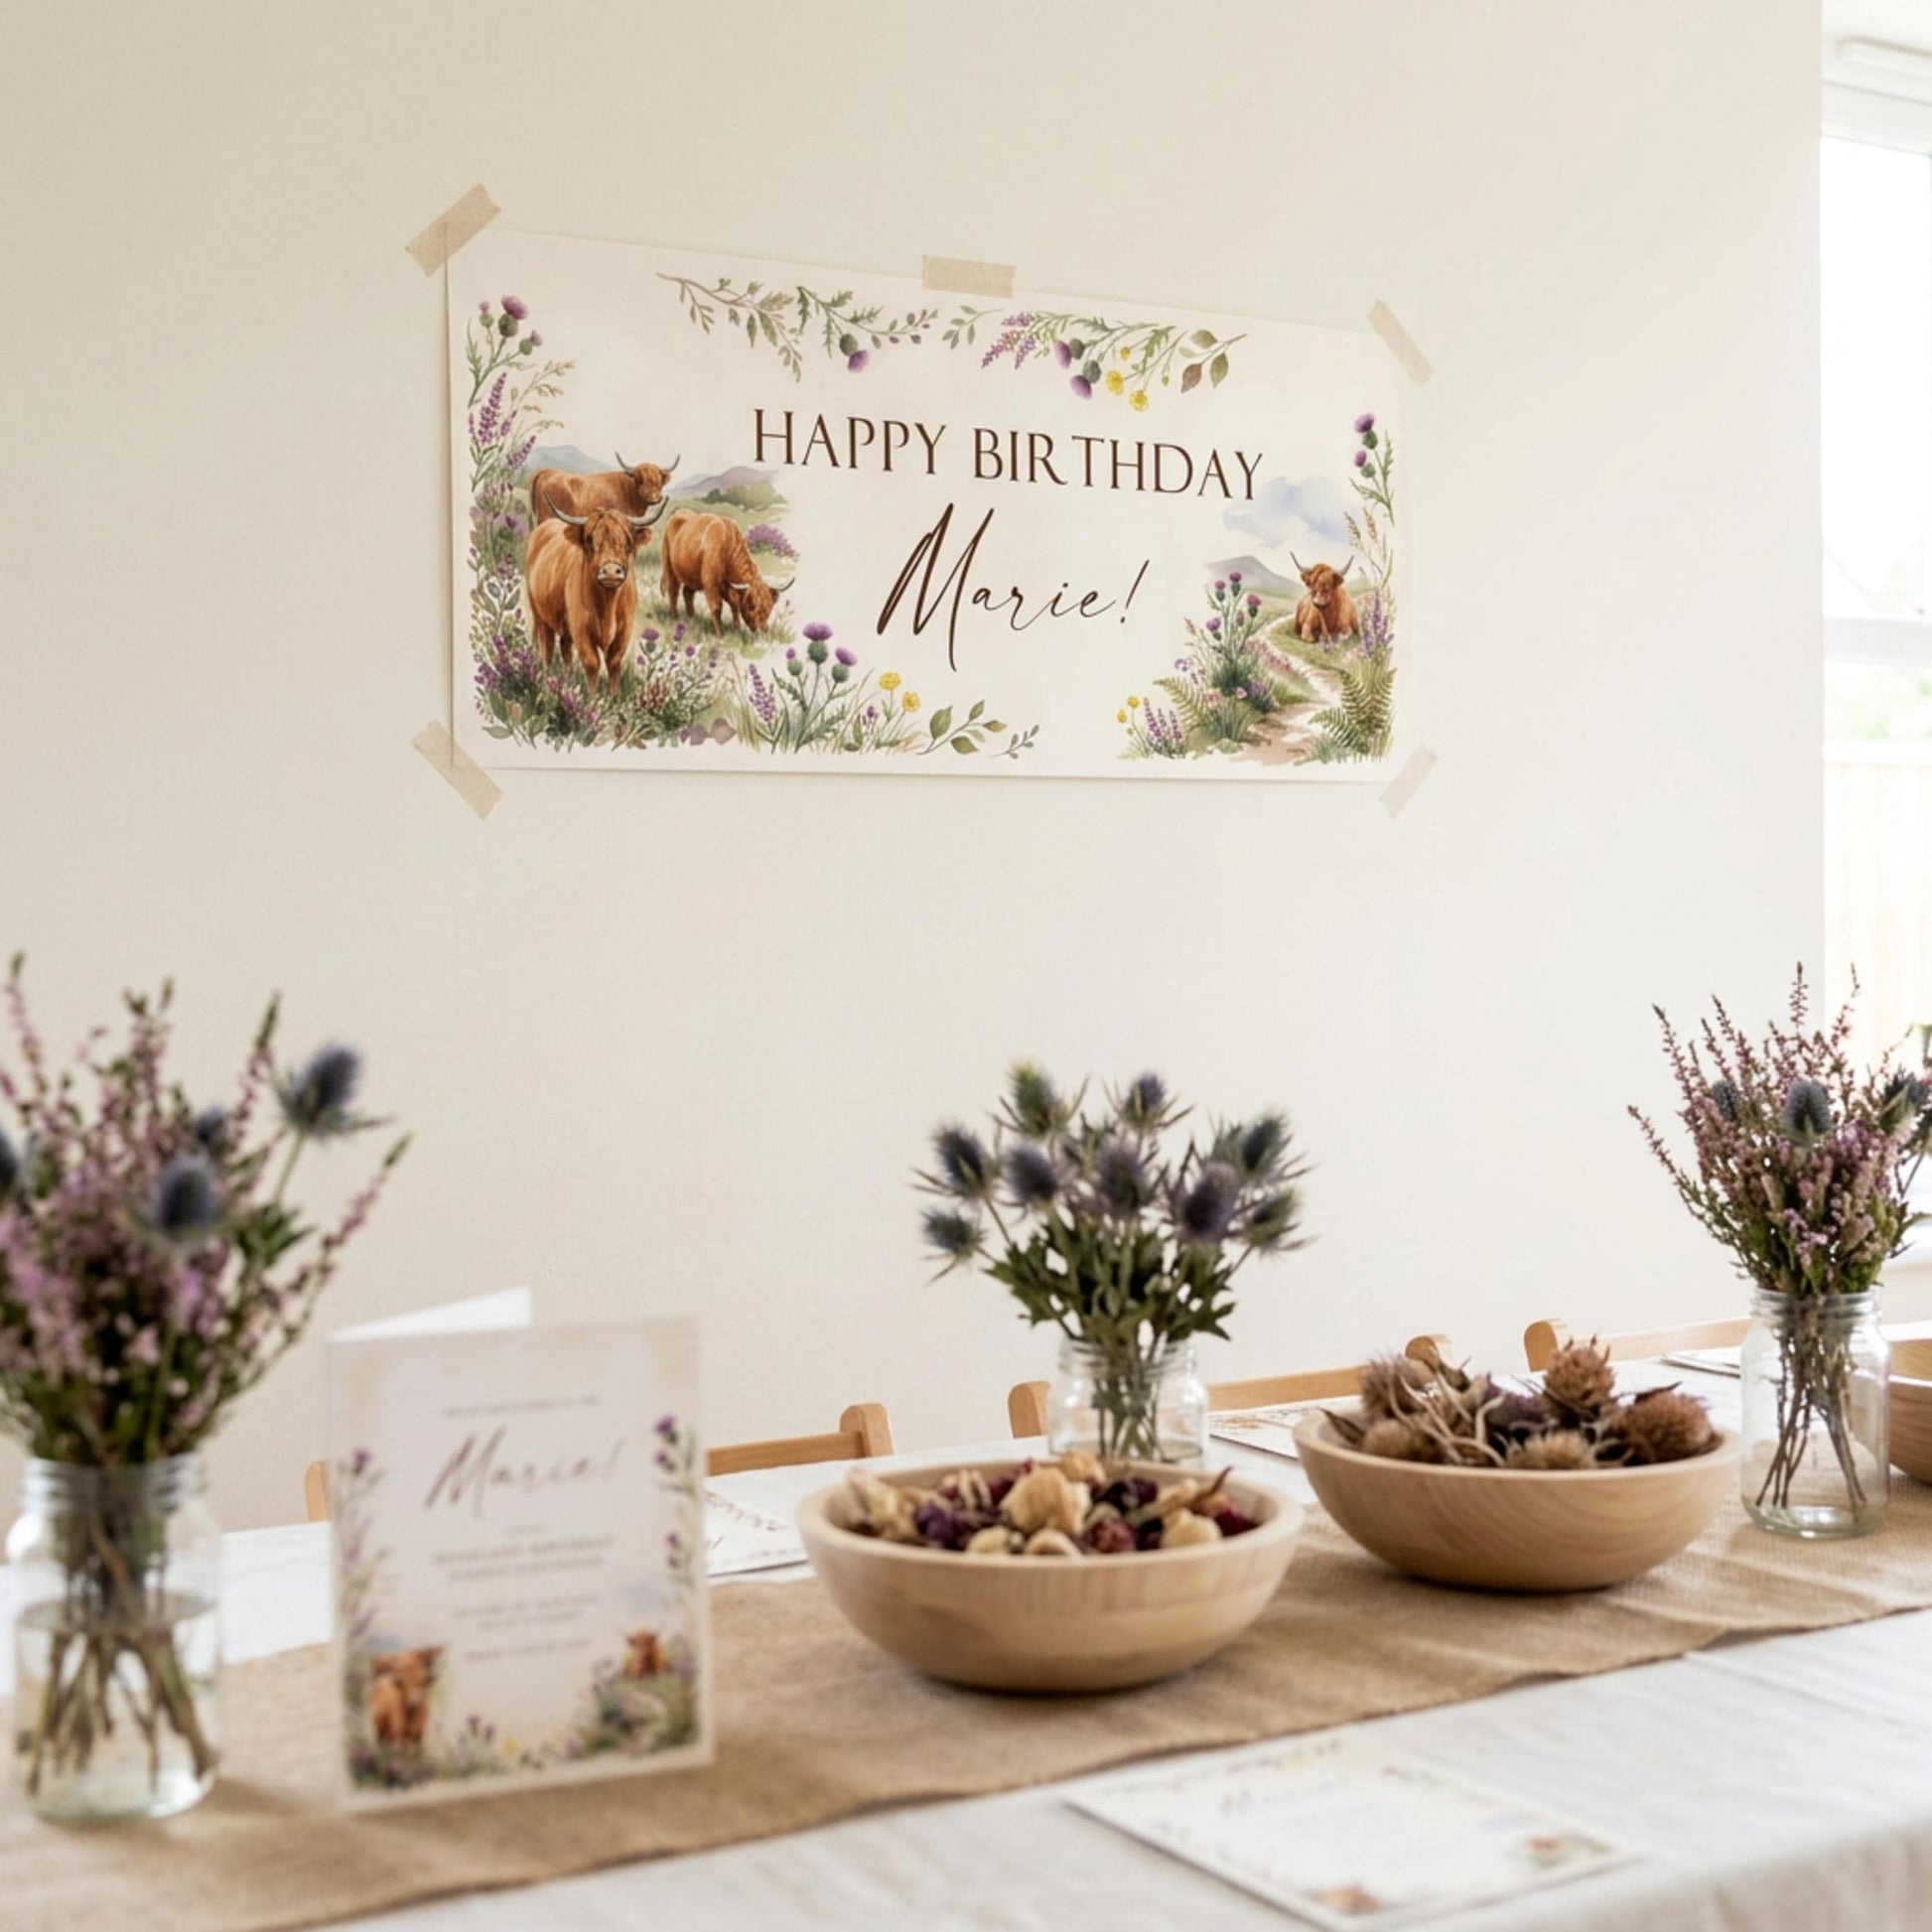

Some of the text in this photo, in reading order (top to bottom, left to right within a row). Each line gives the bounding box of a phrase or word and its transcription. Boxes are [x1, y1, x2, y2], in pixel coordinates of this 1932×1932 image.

[755, 409, 1262, 500] HAPPY BIRTHDAY
[877, 502, 1150, 672] Marie!
